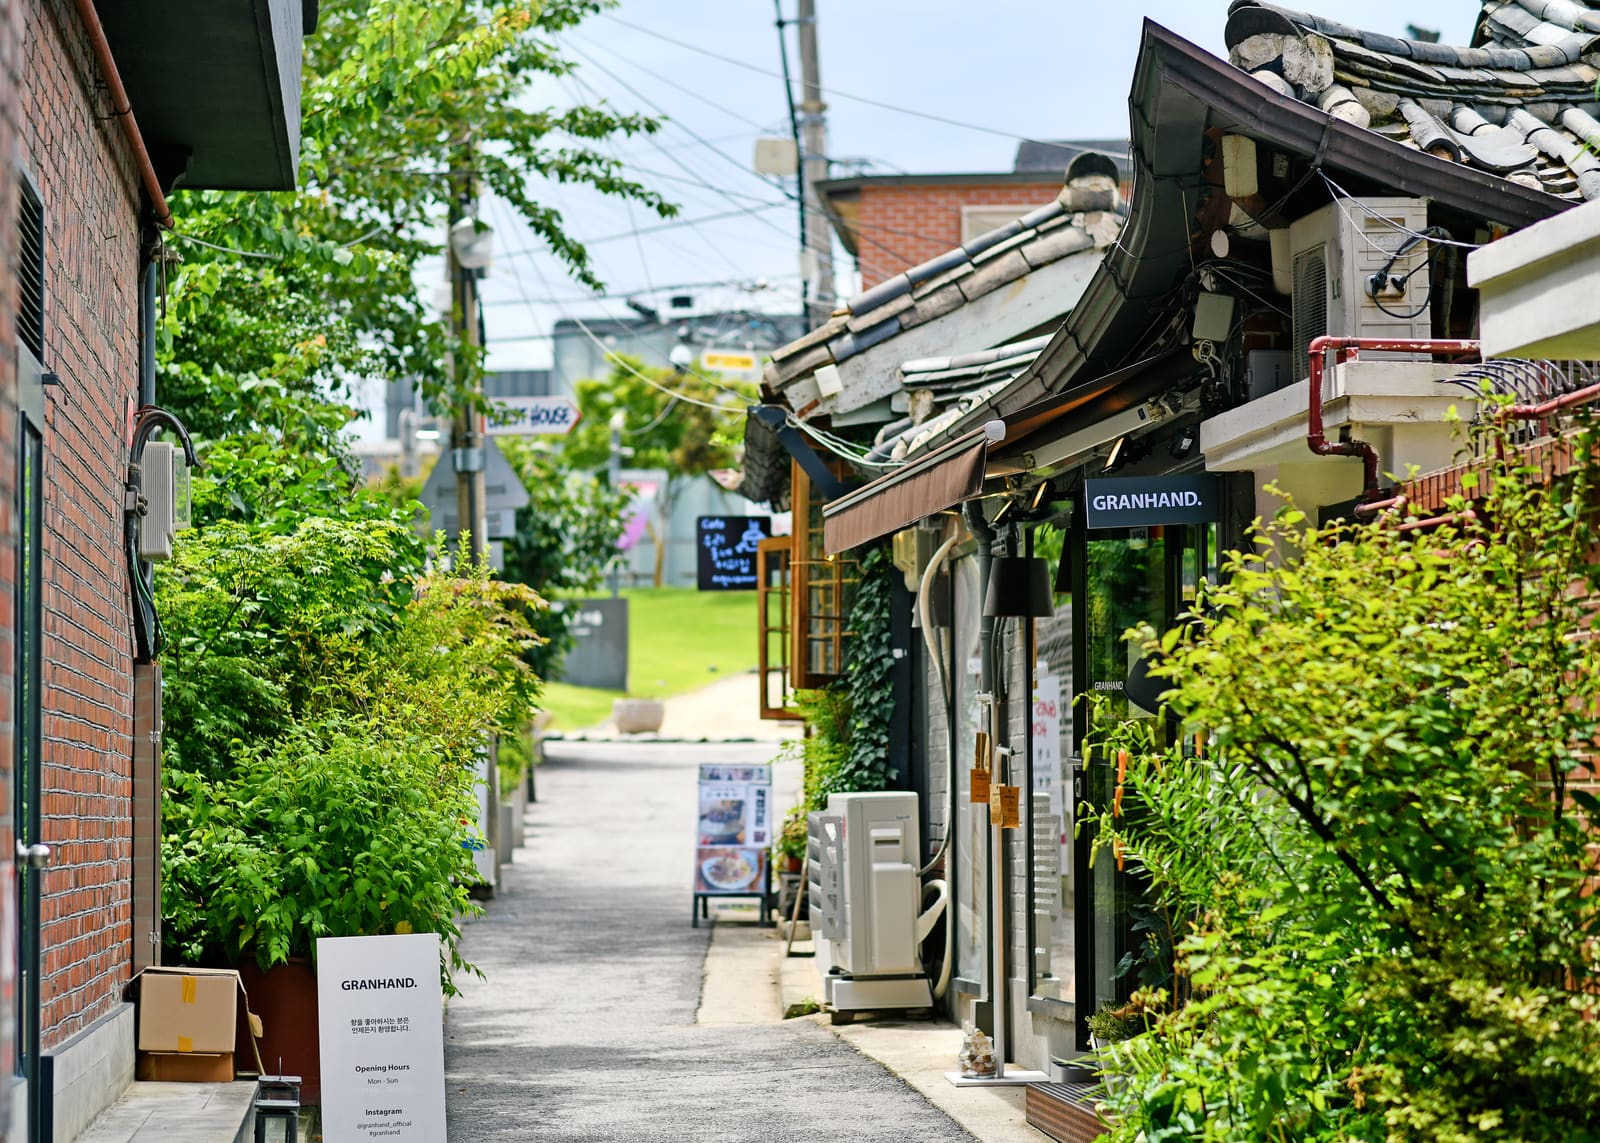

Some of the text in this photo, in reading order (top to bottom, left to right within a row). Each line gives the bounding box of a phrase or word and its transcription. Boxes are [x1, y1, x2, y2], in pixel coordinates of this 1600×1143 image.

[1332, 277, 1341, 300] LG
[531, 405, 569, 427] HOUSE
[1092, 491, 1202, 511] GRANHAND.
[1094, 681, 1124, 691] GRANHAND
[341, 977, 418, 991] GRANHAND.
[350, 1016, 409, 1027] 향을 좋아하시는 분은
[351, 1025, 411, 1034] 언제든지 환영합니다.
[355, 1065, 387, 1073] Opening
[365, 1108, 403, 1116] Instagram
[357, 1120, 412, 1130] @granhand_official
[369, 1129, 401, 1137] #granhand
